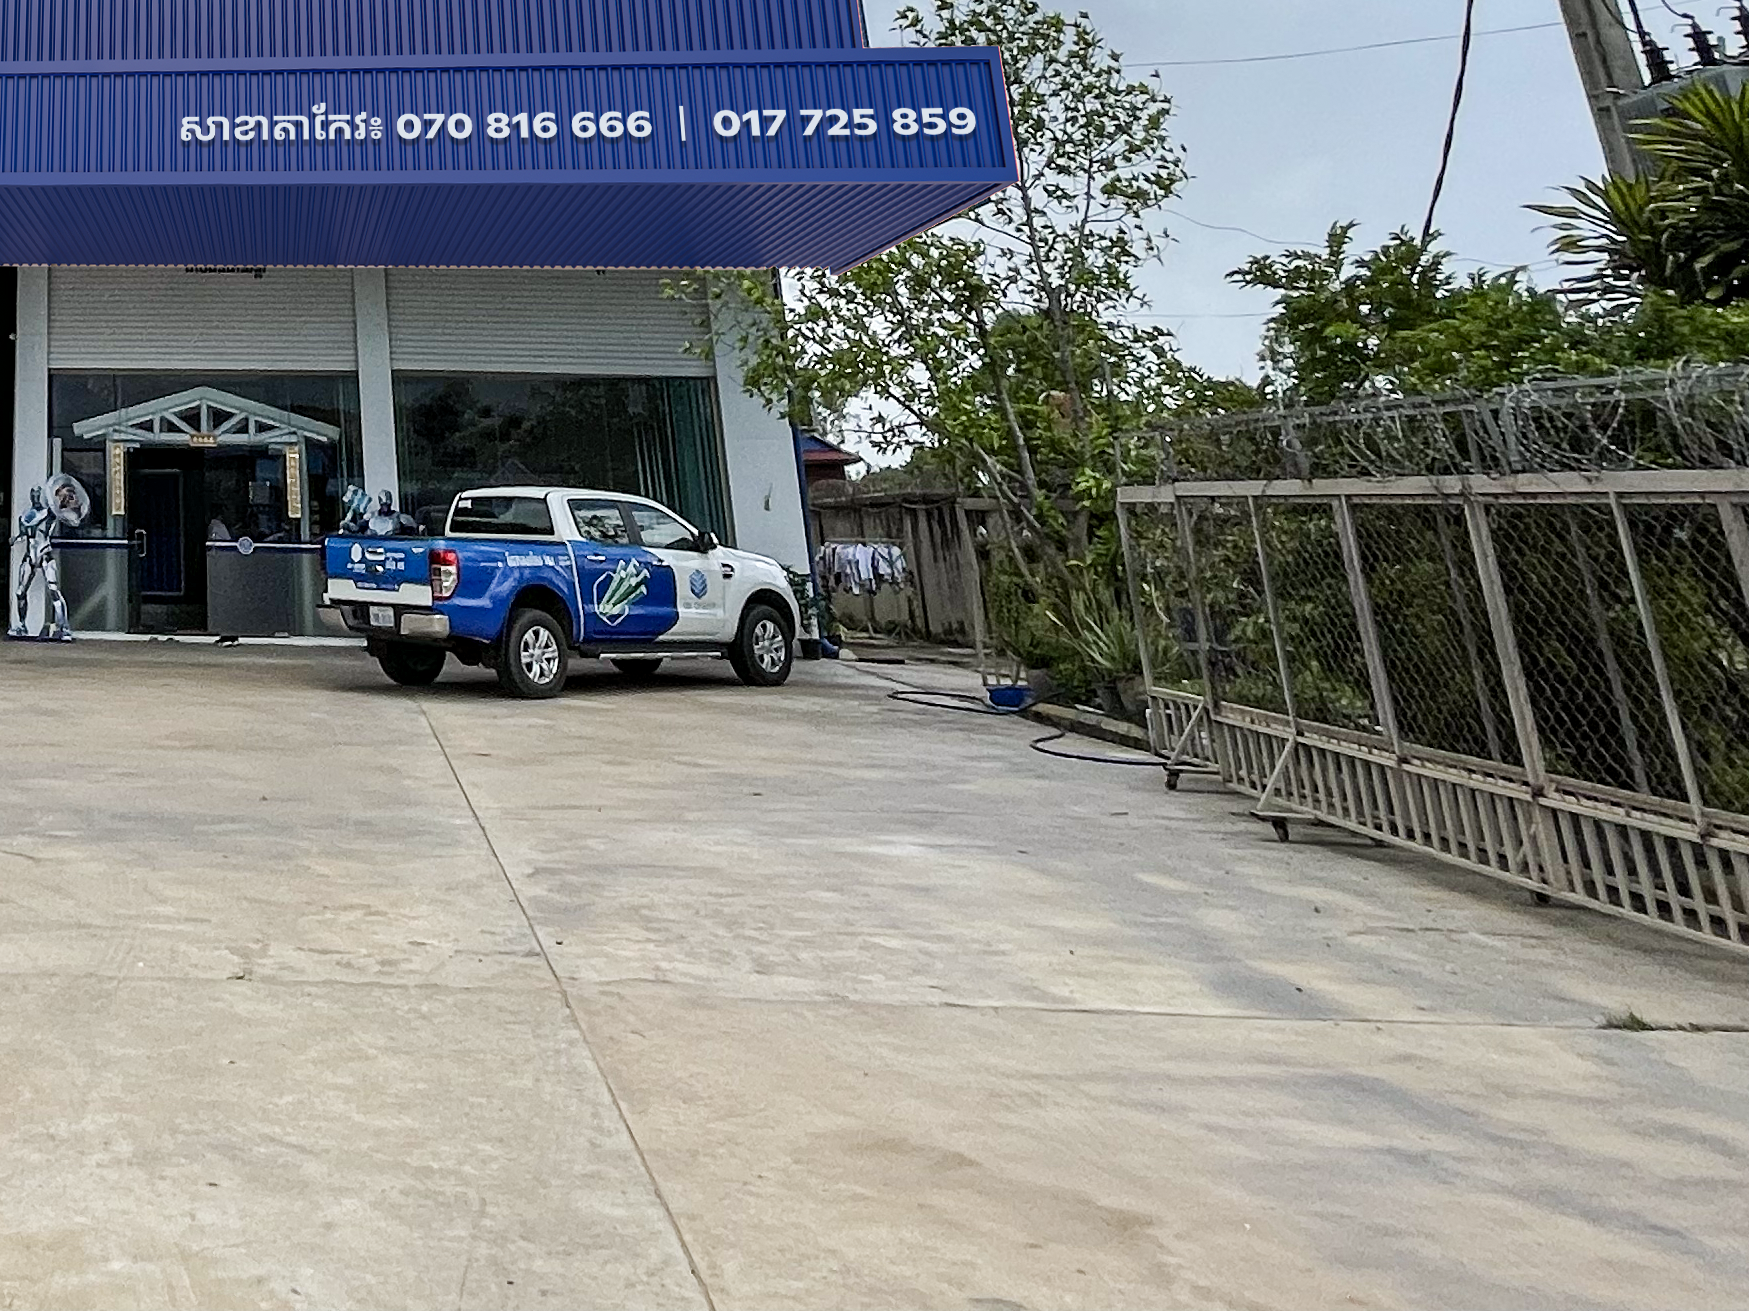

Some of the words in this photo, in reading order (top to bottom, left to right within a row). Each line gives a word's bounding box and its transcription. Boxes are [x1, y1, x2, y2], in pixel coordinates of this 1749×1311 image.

[396, 112, 473, 140] 070
[486, 111, 558, 139] 816
[571, 110, 653, 138] 666
[713, 109, 787, 137] 017
[799, 108, 878, 136] 725
[891, 107, 977, 136] 859
